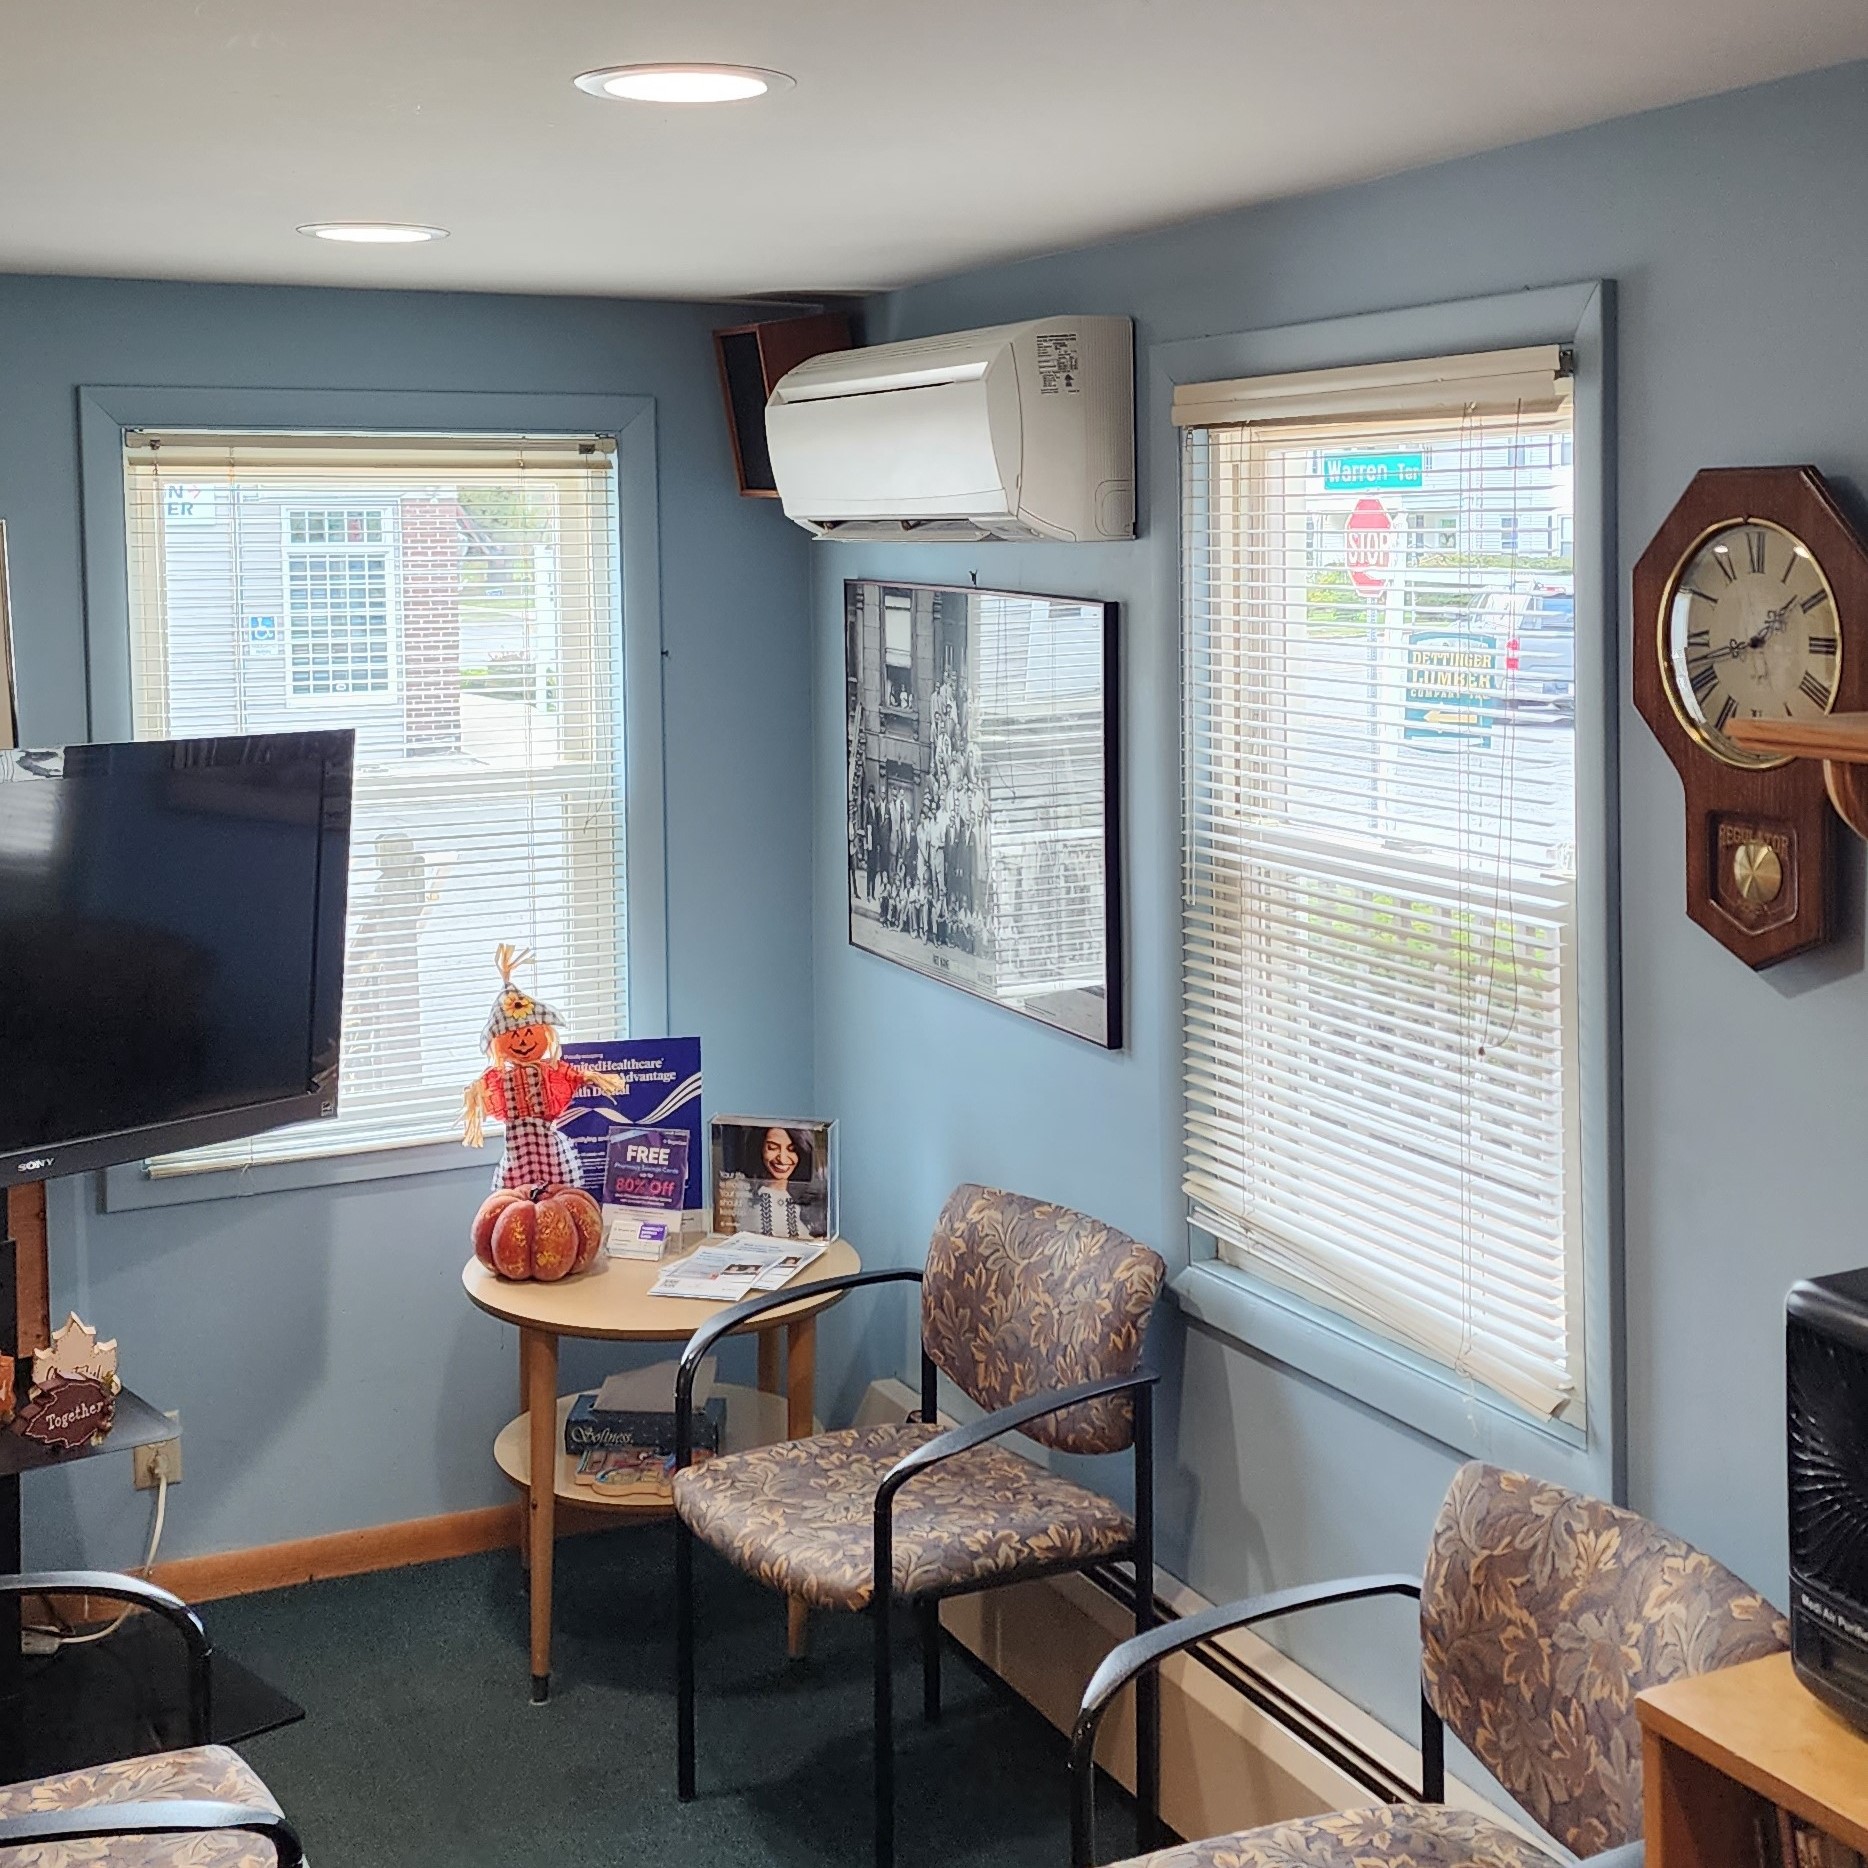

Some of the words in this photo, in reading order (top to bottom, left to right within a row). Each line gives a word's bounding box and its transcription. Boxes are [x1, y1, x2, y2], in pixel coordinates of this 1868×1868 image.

[1327, 458, 1388, 483] Warren
[1397, 463, 1420, 482] Ter
[1347, 532, 1390, 567] STOP
[1412, 650, 1492, 669] DETTINGER
[1411, 668, 1491, 690] LUMBER
[17, 1158, 55, 1172] SONY
[626, 1144, 671, 1166] FREE
[616, 1177, 645, 1193] 80%
[650, 1179, 676, 1197] Off
[46, 1401, 104, 1431] Together
